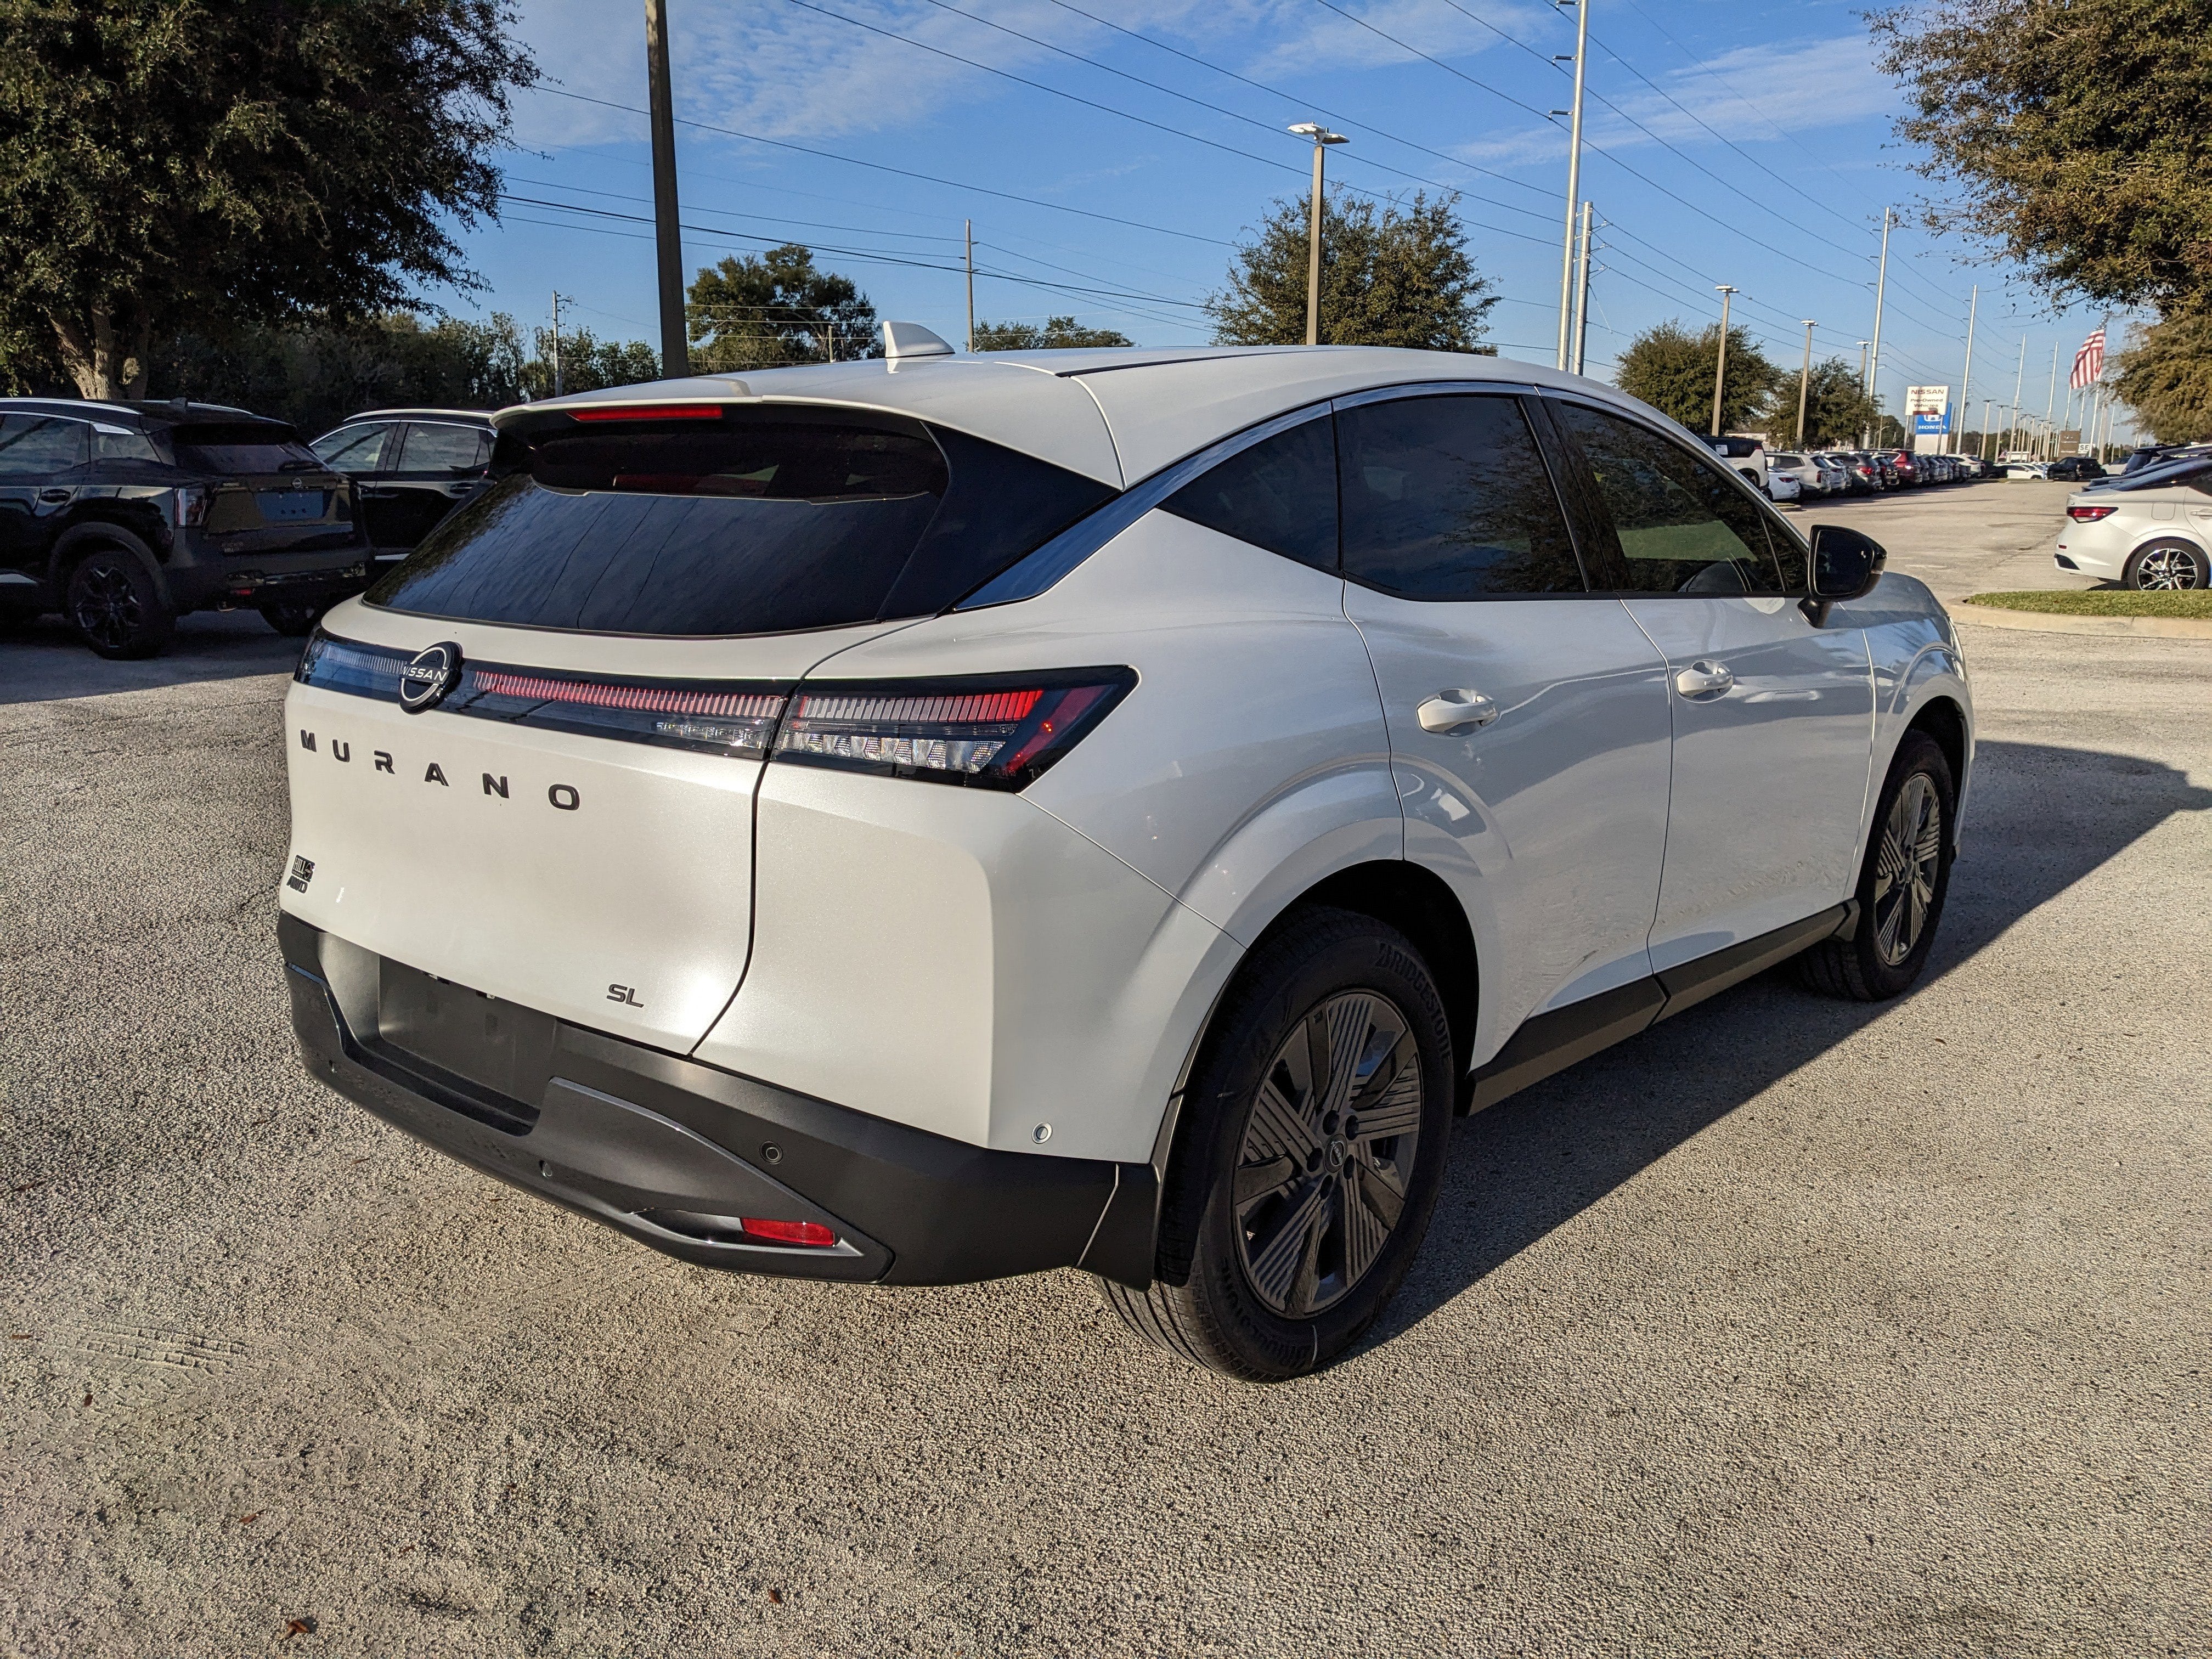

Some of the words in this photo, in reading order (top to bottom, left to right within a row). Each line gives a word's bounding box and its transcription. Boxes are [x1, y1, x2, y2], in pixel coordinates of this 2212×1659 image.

[400, 665, 447, 683] NISSAN
[300, 729, 581, 811] MURANO
[606, 984, 645, 1008] SL
[1375, 942, 1453, 1066] BRIDGESTONE
